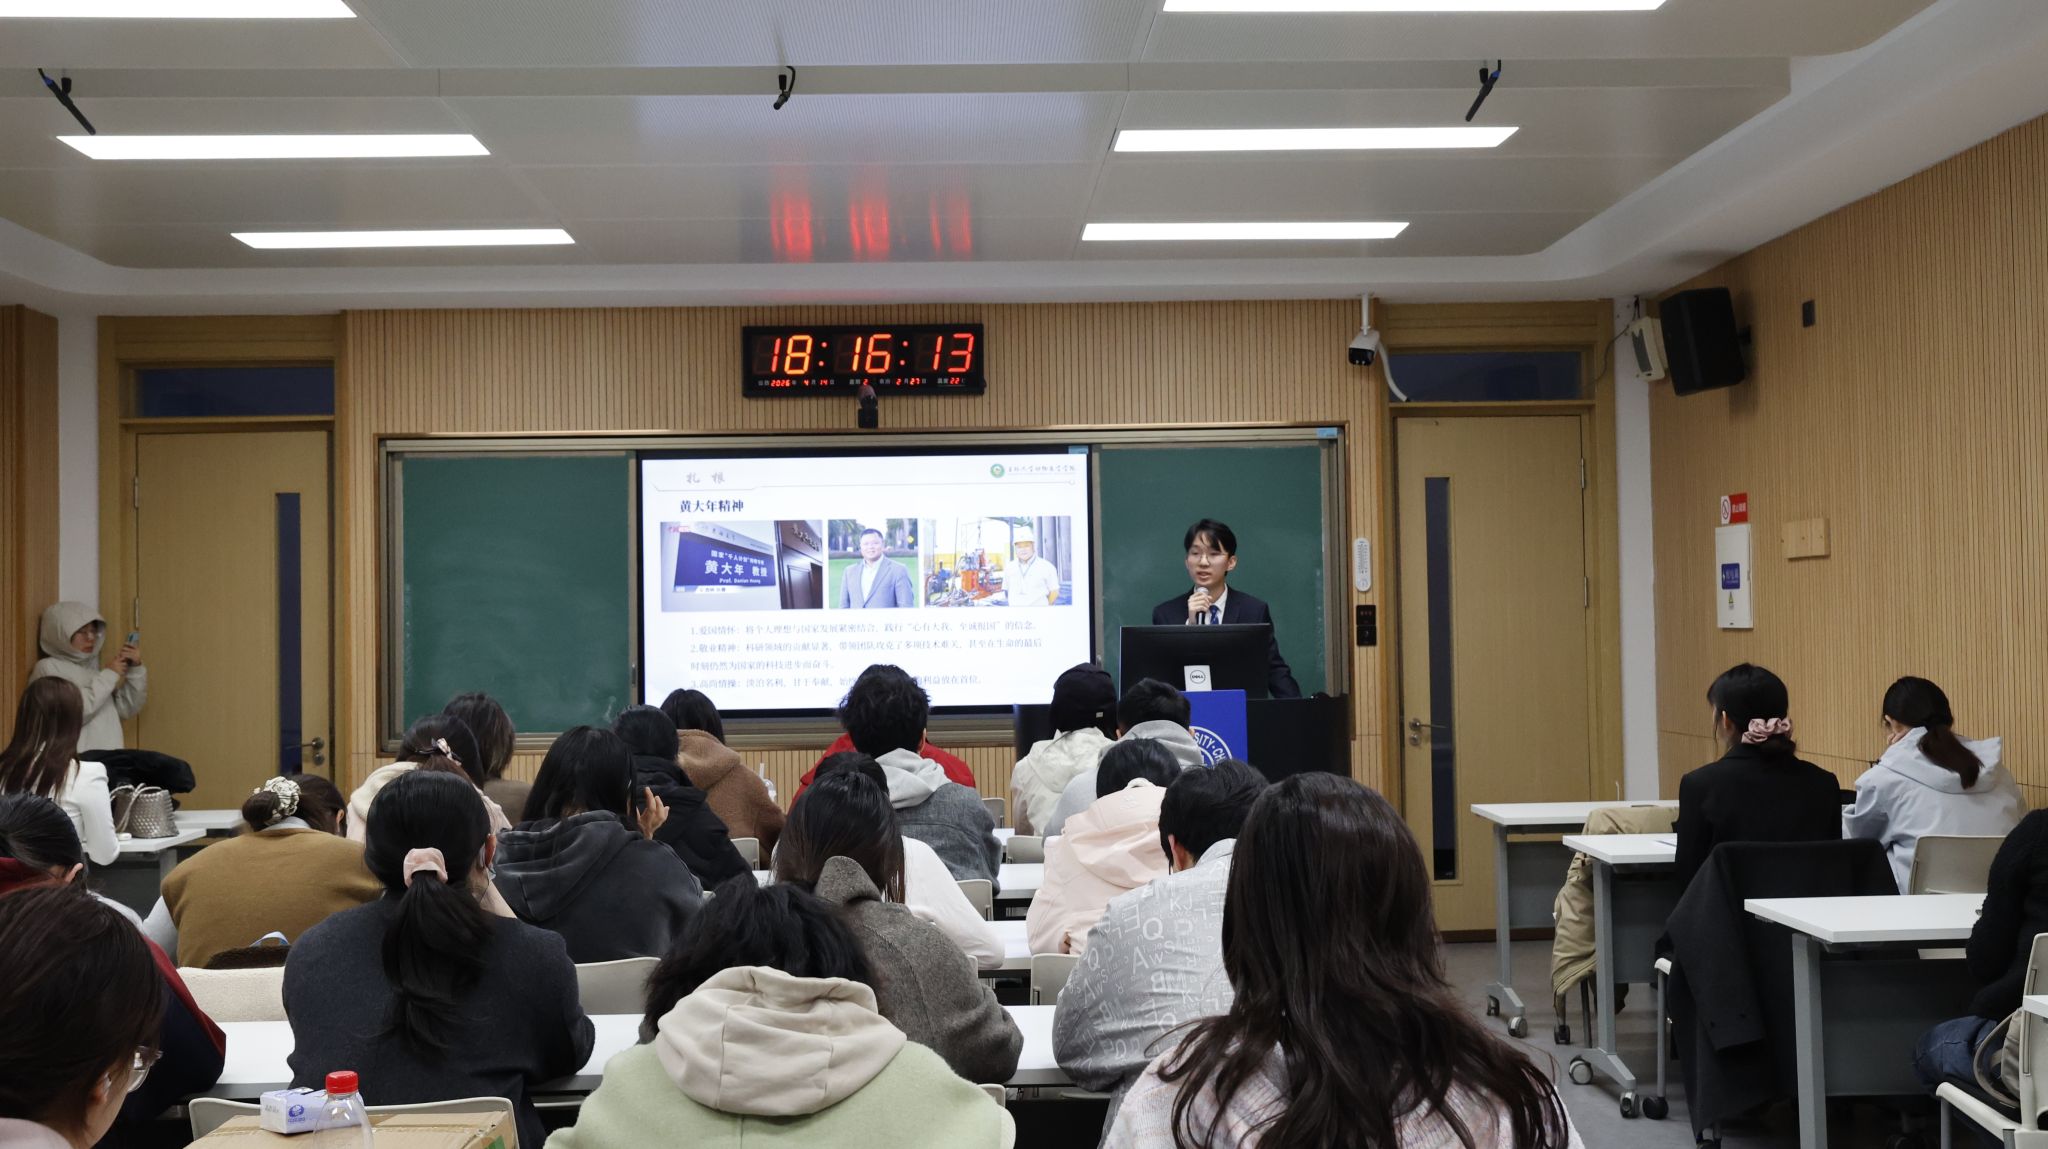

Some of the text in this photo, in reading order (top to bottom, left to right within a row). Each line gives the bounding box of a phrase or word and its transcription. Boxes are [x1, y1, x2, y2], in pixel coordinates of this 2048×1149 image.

[771, 332, 975, 375] 18:16:13
[680, 499, 744, 513] 黄大年精神
[704, 559, 768, 578] 黄大年 教授
